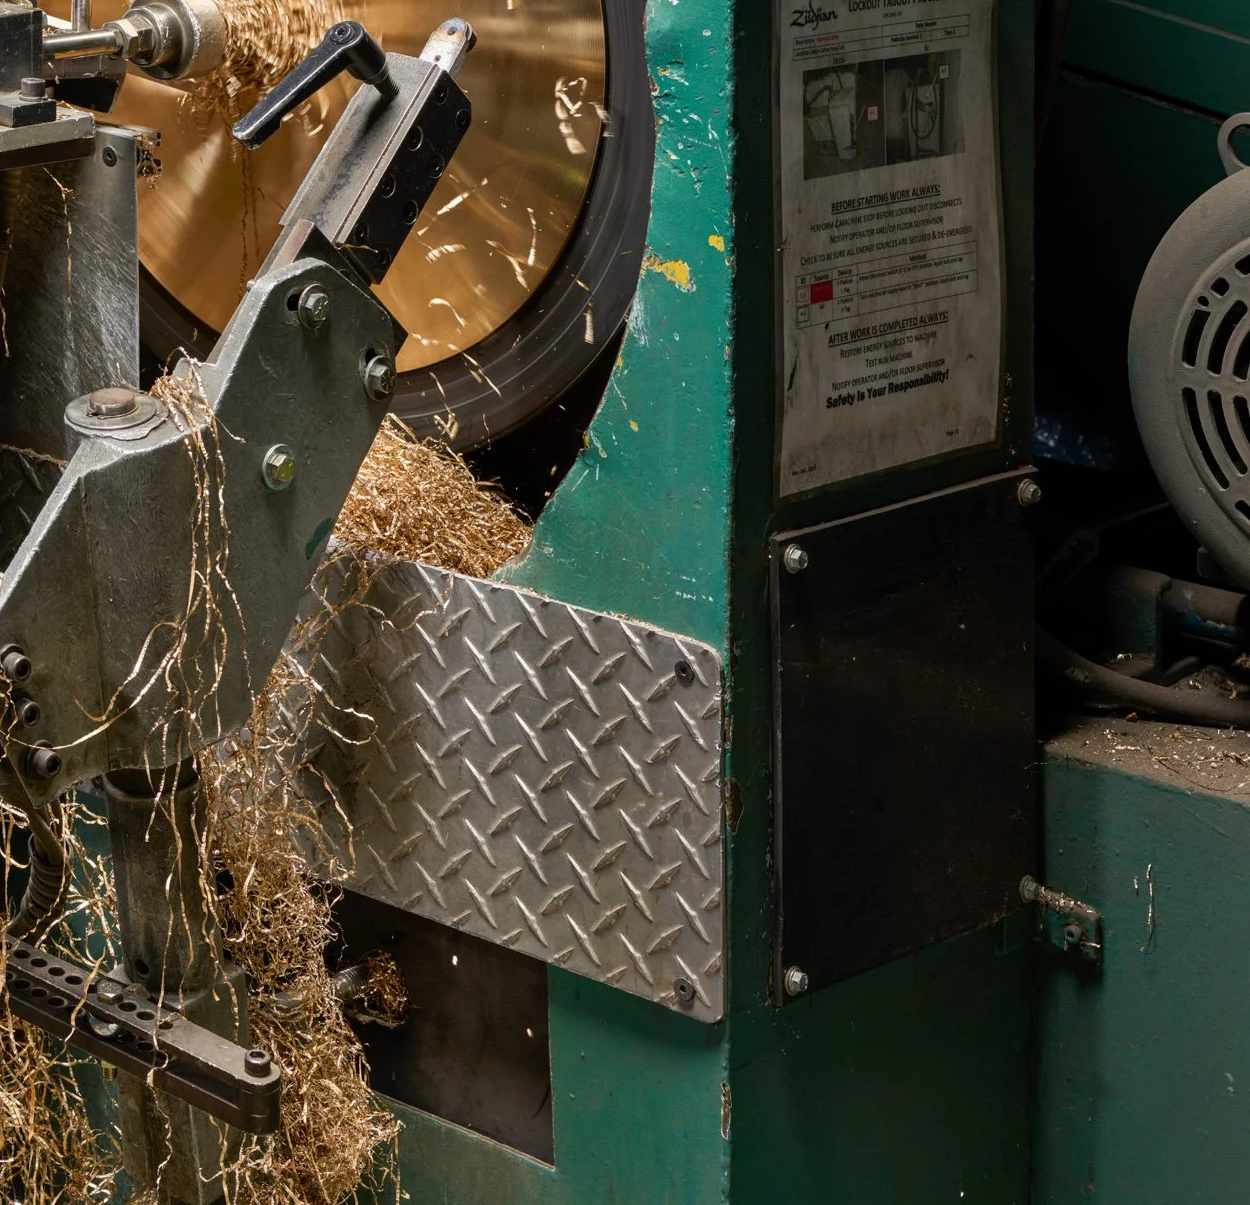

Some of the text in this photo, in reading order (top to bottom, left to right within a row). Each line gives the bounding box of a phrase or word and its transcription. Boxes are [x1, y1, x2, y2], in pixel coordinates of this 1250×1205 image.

[790, 0, 838, 31] Zildjian
[831, 184, 941, 213] BEFORE STARTING WORK ALWAYS:
[810, 221, 834, 233] PERFORM
[863, 213, 875, 224] STOP
[876, 209, 895, 220] BEFORE
[896, 205, 917, 217] LOCKING
[918, 203, 928, 213] OUT
[929, 198, 963, 210] DISCONNECTS
[829, 216, 943, 245] NOTIFY OPERATOR AND/OR FLOOR SUPERVISOR
[801, 254, 817, 266] CHECK
[818, 254, 826, 262] TO
[833, 249, 845, 260] SURE
[846, 247, 855, 256] ALL
[856, 243, 875, 254] ENERGY
[875, 239, 898, 251] SOURCES
[898, 237, 908, 246] ARE
[909, 233, 931, 245] SECURED
[932, 230, 937, 240] &
[828, 311, 949, 345] AFTER WORK IS COMPLETED ALWAYS:
[840, 330, 937, 359] RESTORE ENERGY SOURCES TO MACHINE
[865, 350, 913, 368] TEST RUN MACHINE
[826, 392, 855, 409] Safety
[867, 386, 886, 399] Your
[888, 368, 949, 393] Responsibility!
[832, 358, 946, 392] NOTIFY OPERATOR AND/OR FLOOR SUPERVISOR
